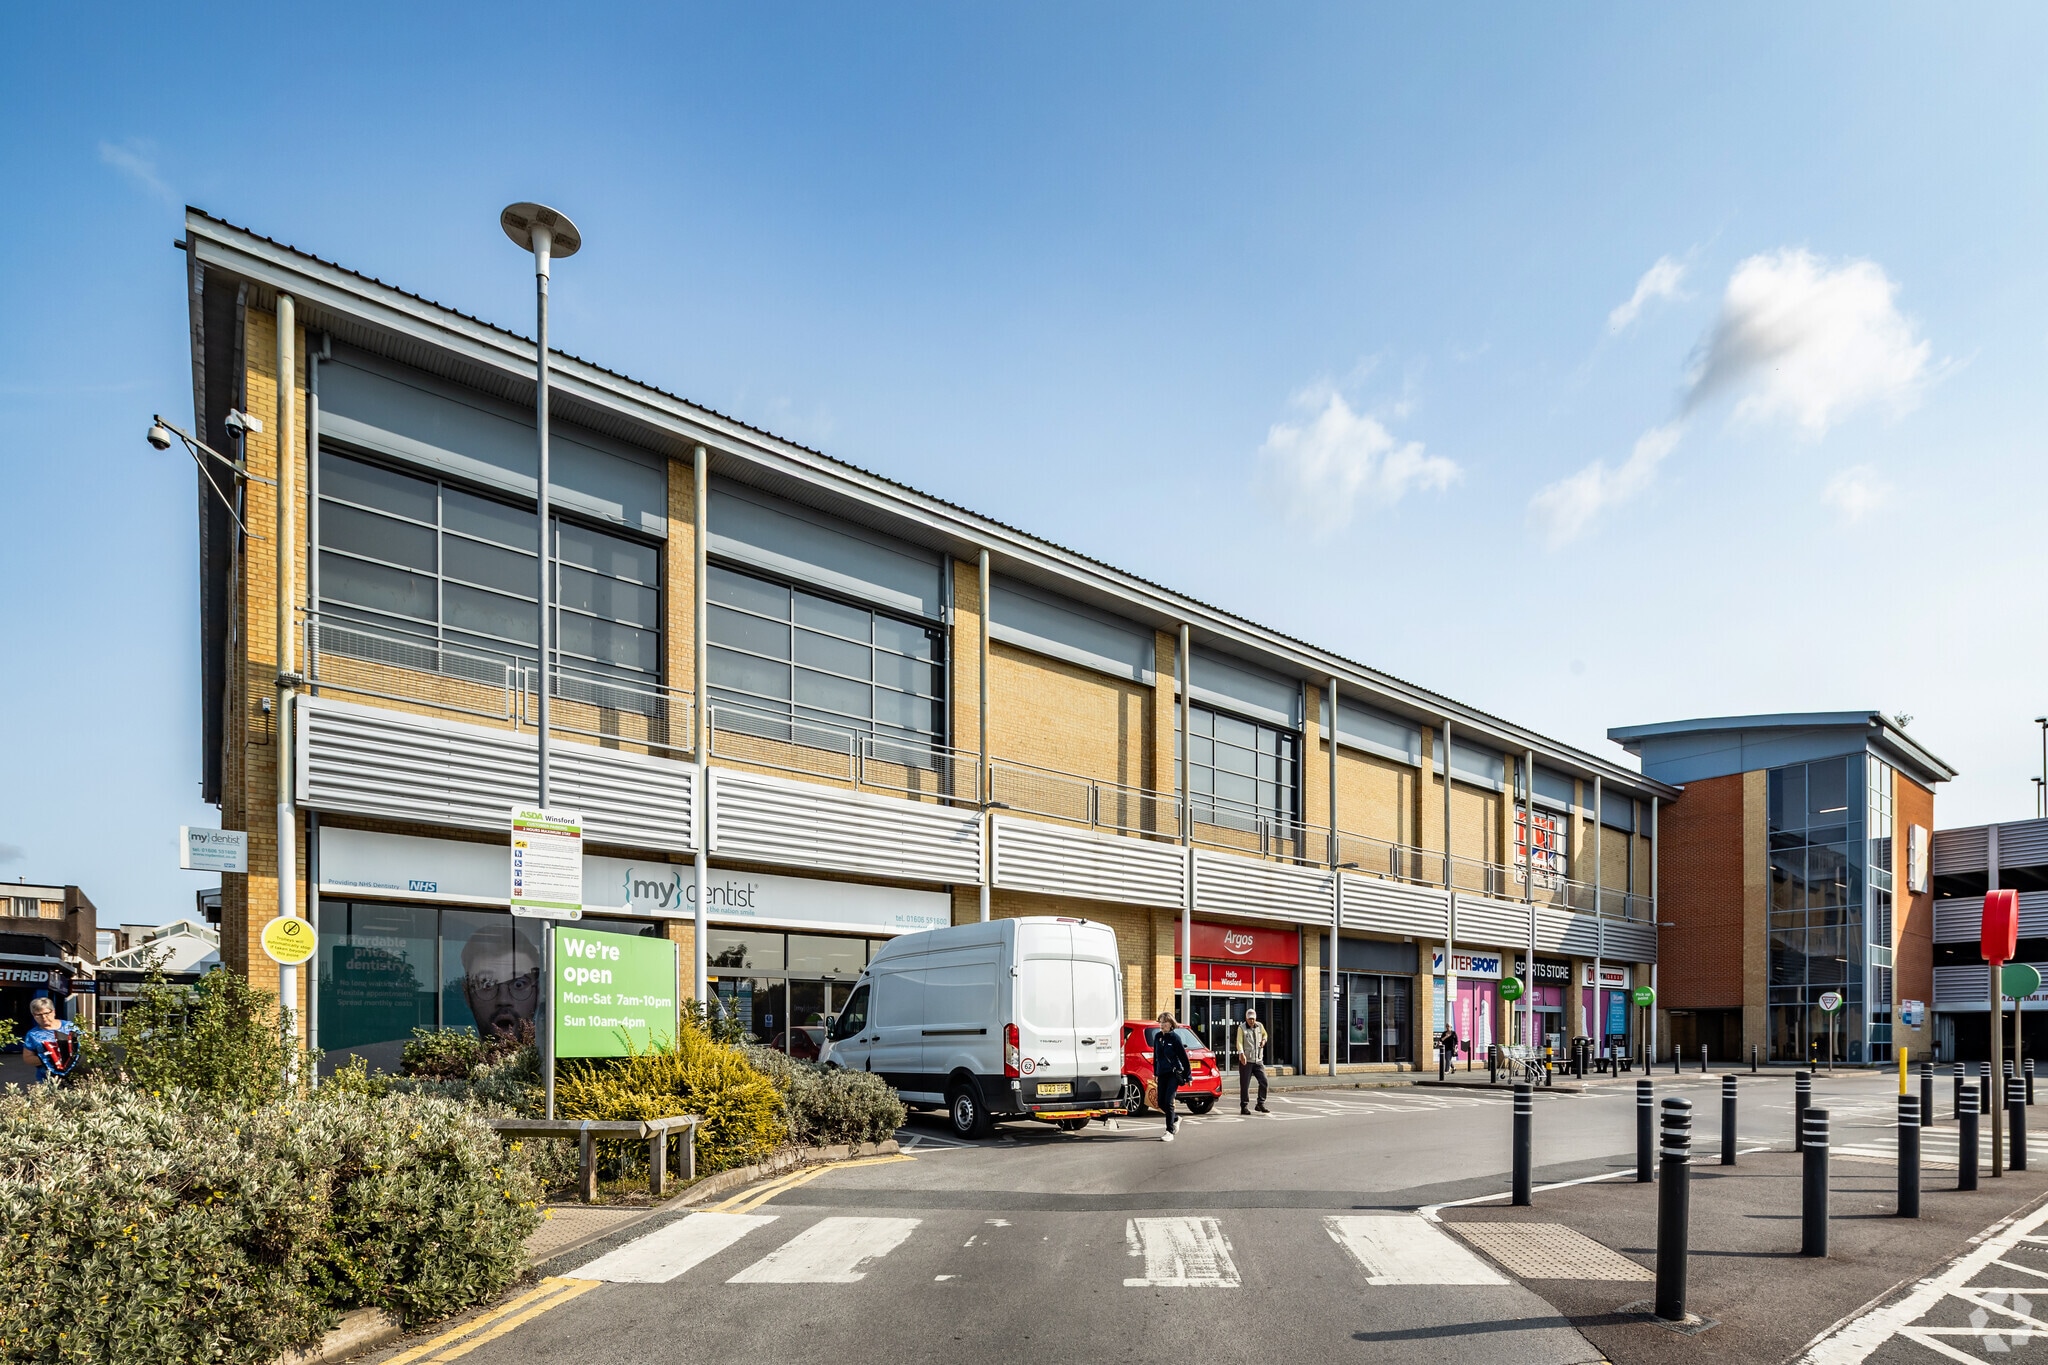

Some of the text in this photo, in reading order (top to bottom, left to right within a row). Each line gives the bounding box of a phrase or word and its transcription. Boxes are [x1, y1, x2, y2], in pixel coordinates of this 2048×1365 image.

[520, 811, 575, 825] ASDA Winsford
[328, 879, 358, 887] Providing
[409, 880, 437, 892] NHS
[709, 904, 720, 912] the
[721, 906, 739, 914] nation
[740, 907, 755, 916] smile
[906, 915, 925, 923] 01606
[926, 916, 948, 925] 551600
[1224, 930, 1254, 949] Argos
[564, 938, 620, 960] We're
[346, 958, 406, 973] dentistry
[1515, 961, 1569, 979] SPRTS STORE
[564, 967, 612, 986] open
[337, 998, 362, 1006] Spread
[366, 991, 413, 999] appointments
[563, 992, 671, 1008] Mon-Sat 7am-10pm
[564, 1015, 646, 1029] Sun 10am-4pm
